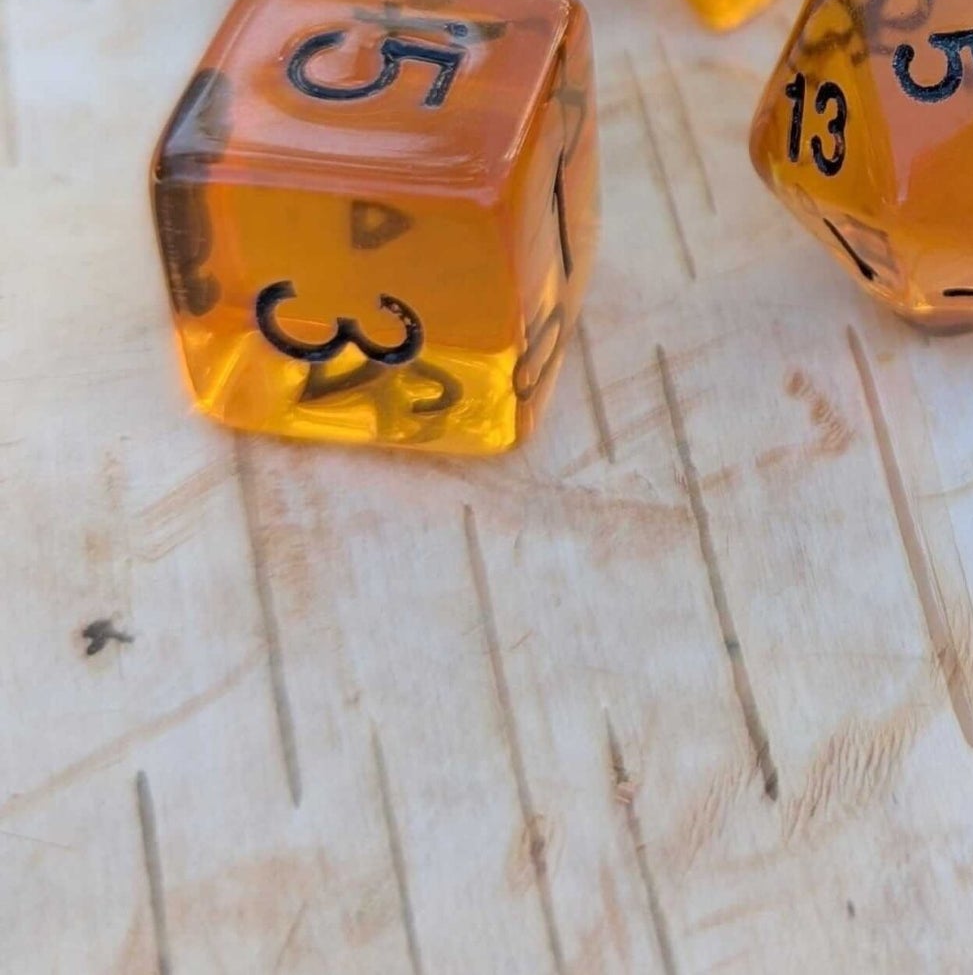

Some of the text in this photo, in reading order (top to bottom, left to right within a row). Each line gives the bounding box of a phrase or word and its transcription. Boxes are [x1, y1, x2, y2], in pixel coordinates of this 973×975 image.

[286, 30, 467, 108] 5
[785, 72, 848, 177] 13
[255, 279, 424, 365] 3
